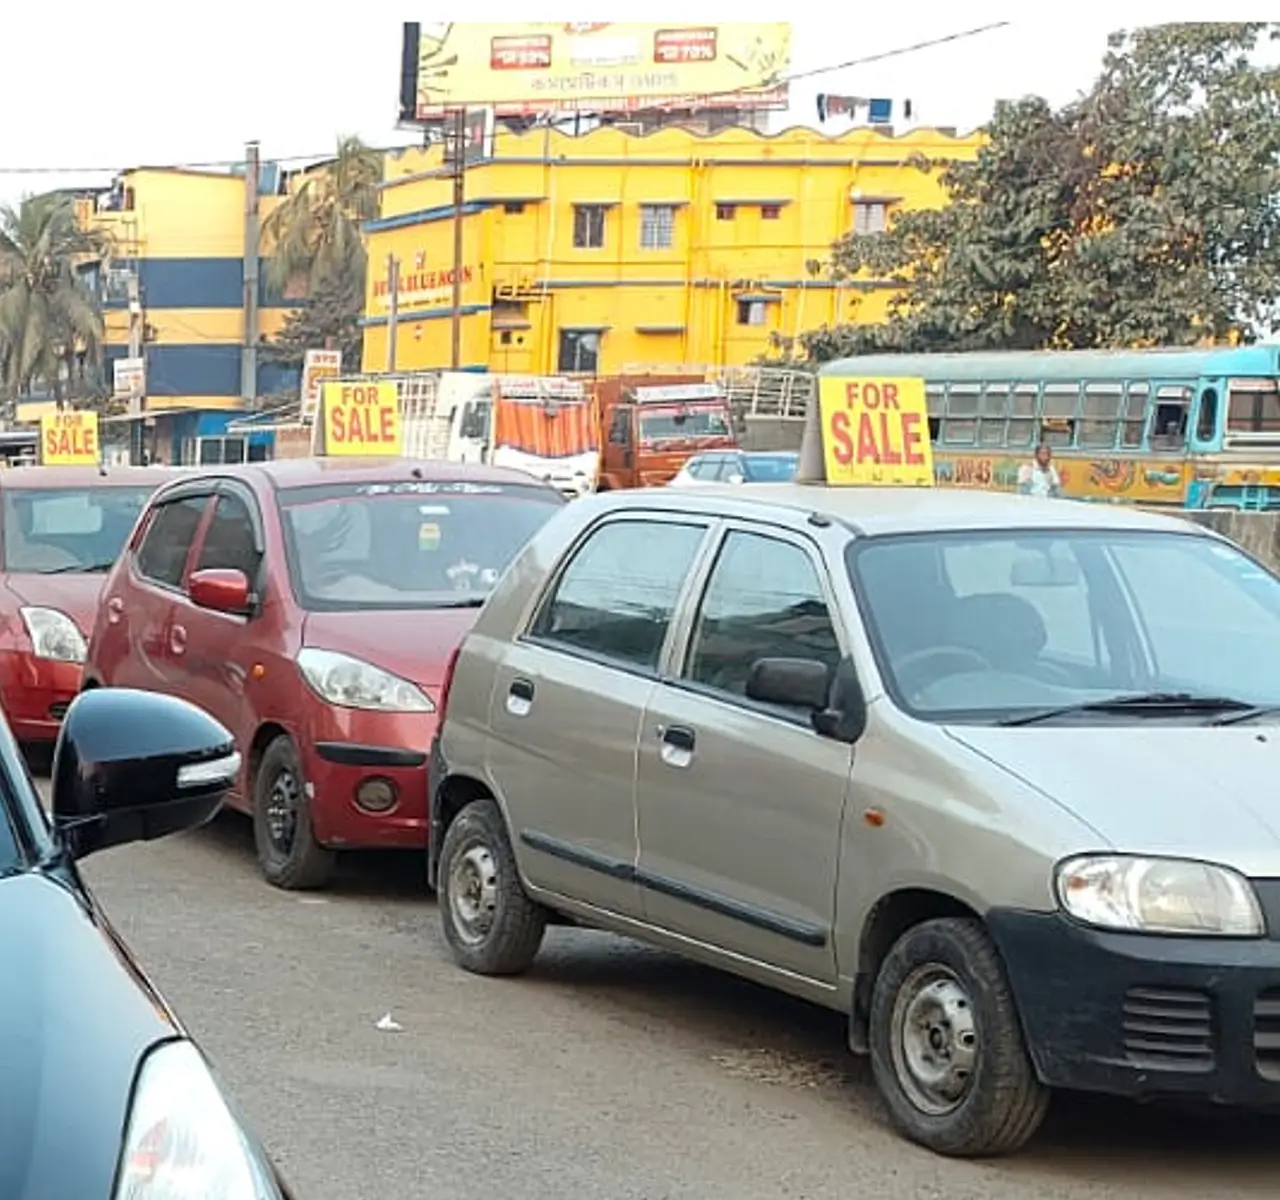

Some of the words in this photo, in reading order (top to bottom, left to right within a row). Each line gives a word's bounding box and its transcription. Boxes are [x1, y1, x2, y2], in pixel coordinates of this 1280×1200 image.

[341, 387, 379, 406] FOR
[845, 382, 900, 410] FOR
[331, 408, 396, 443] SALE
[831, 410, 926, 465] SALE
[46, 430, 96, 455] SALE
